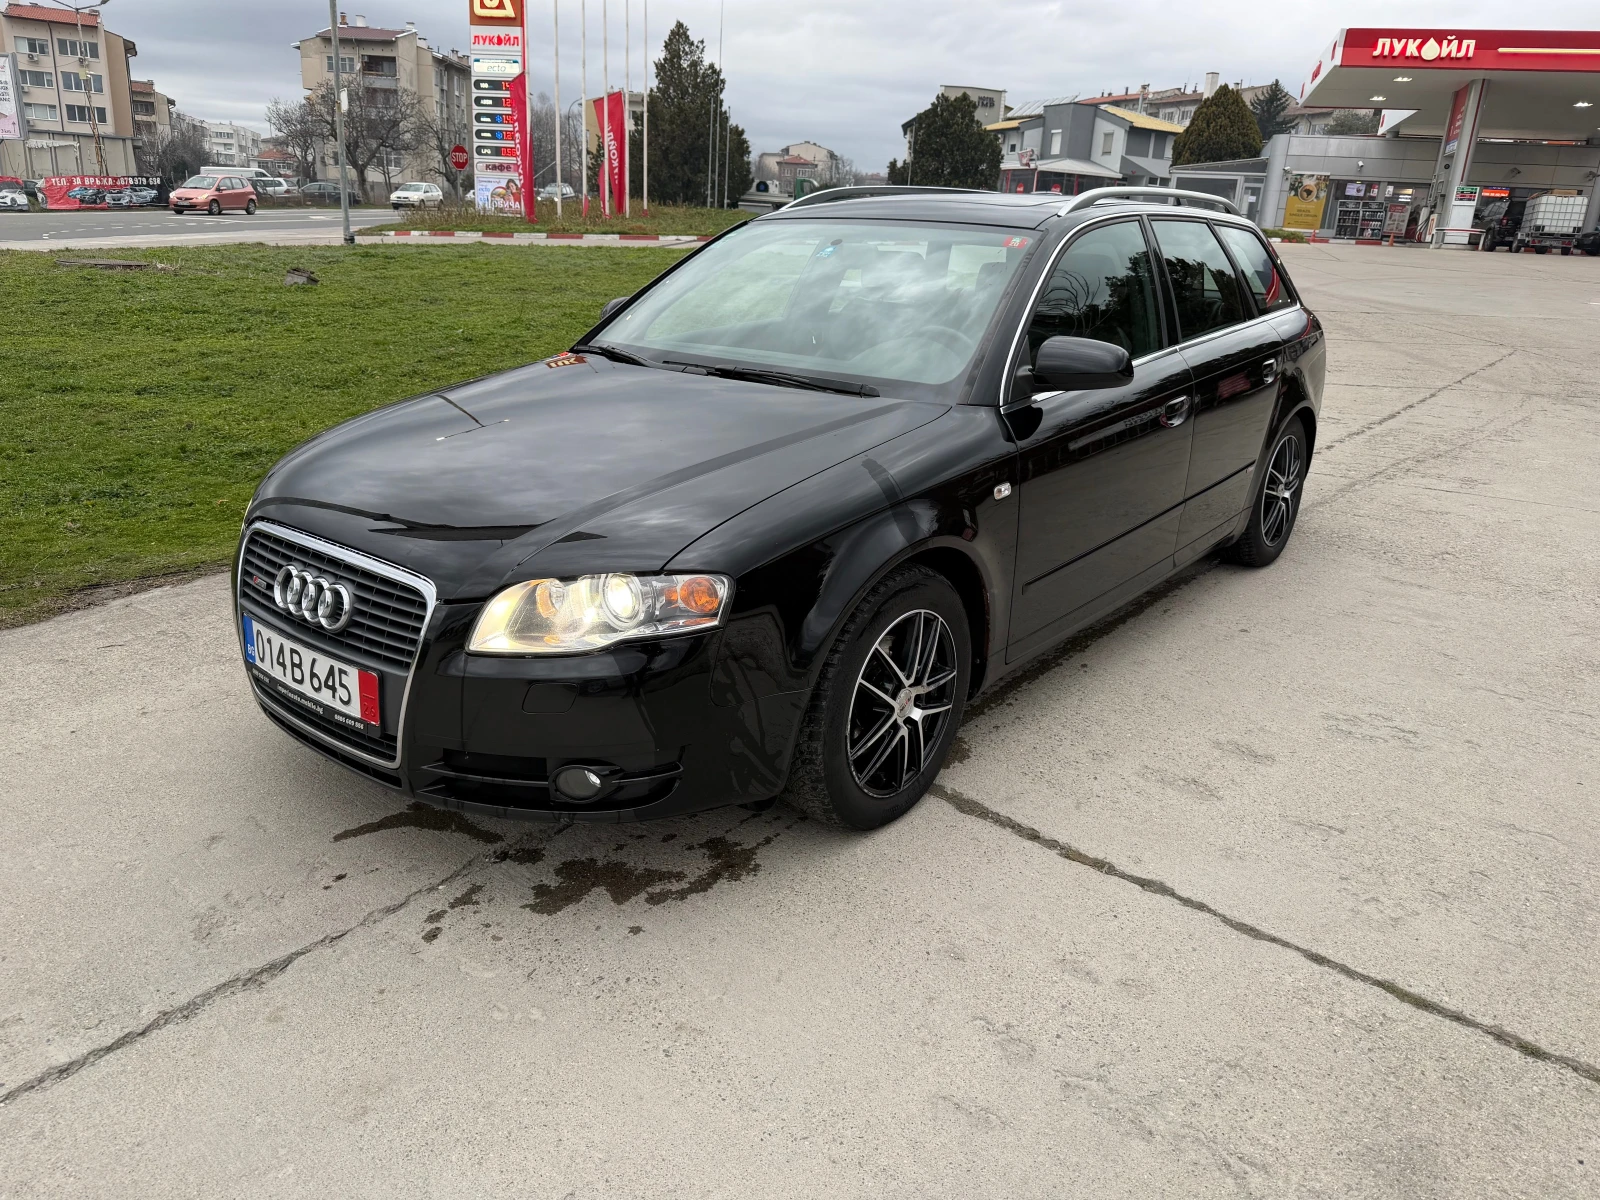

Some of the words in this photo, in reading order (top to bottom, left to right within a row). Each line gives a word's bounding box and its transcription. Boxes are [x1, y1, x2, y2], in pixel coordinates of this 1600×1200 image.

[451, 152, 468, 163] STOP
[485, 163, 512, 172] кафе
[72, 177, 81, 185] ЗА
